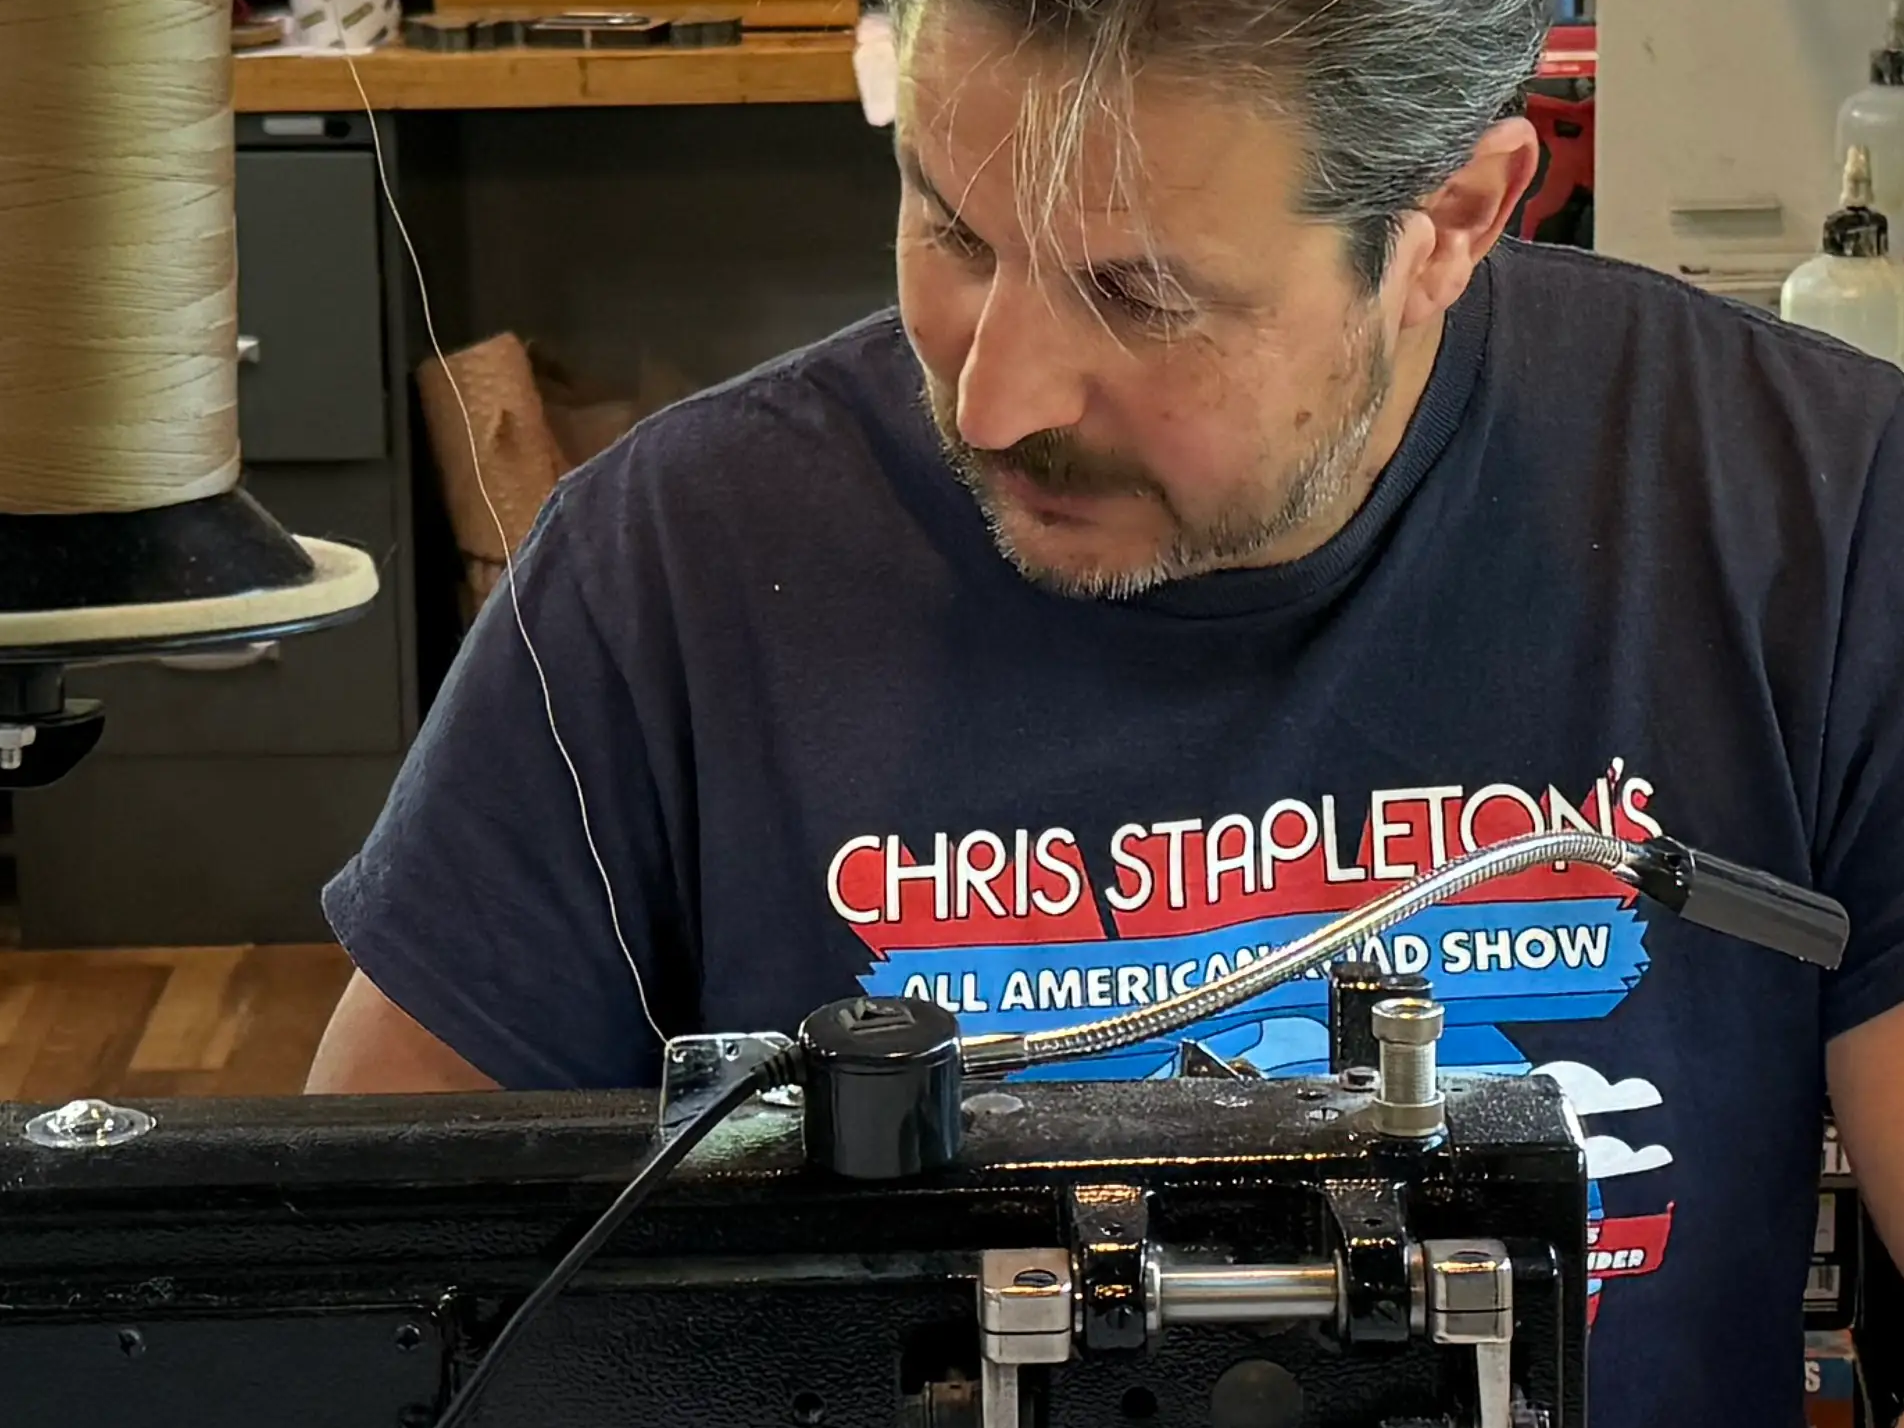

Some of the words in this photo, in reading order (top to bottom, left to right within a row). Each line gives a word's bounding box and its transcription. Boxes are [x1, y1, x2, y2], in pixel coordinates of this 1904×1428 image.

[827, 827, 1082, 923] CHRIS
[1105, 757, 1663, 911] STAPLETON'S
[903, 972, 989, 1012] ALL
[1443, 925, 1609, 973] SHOW
